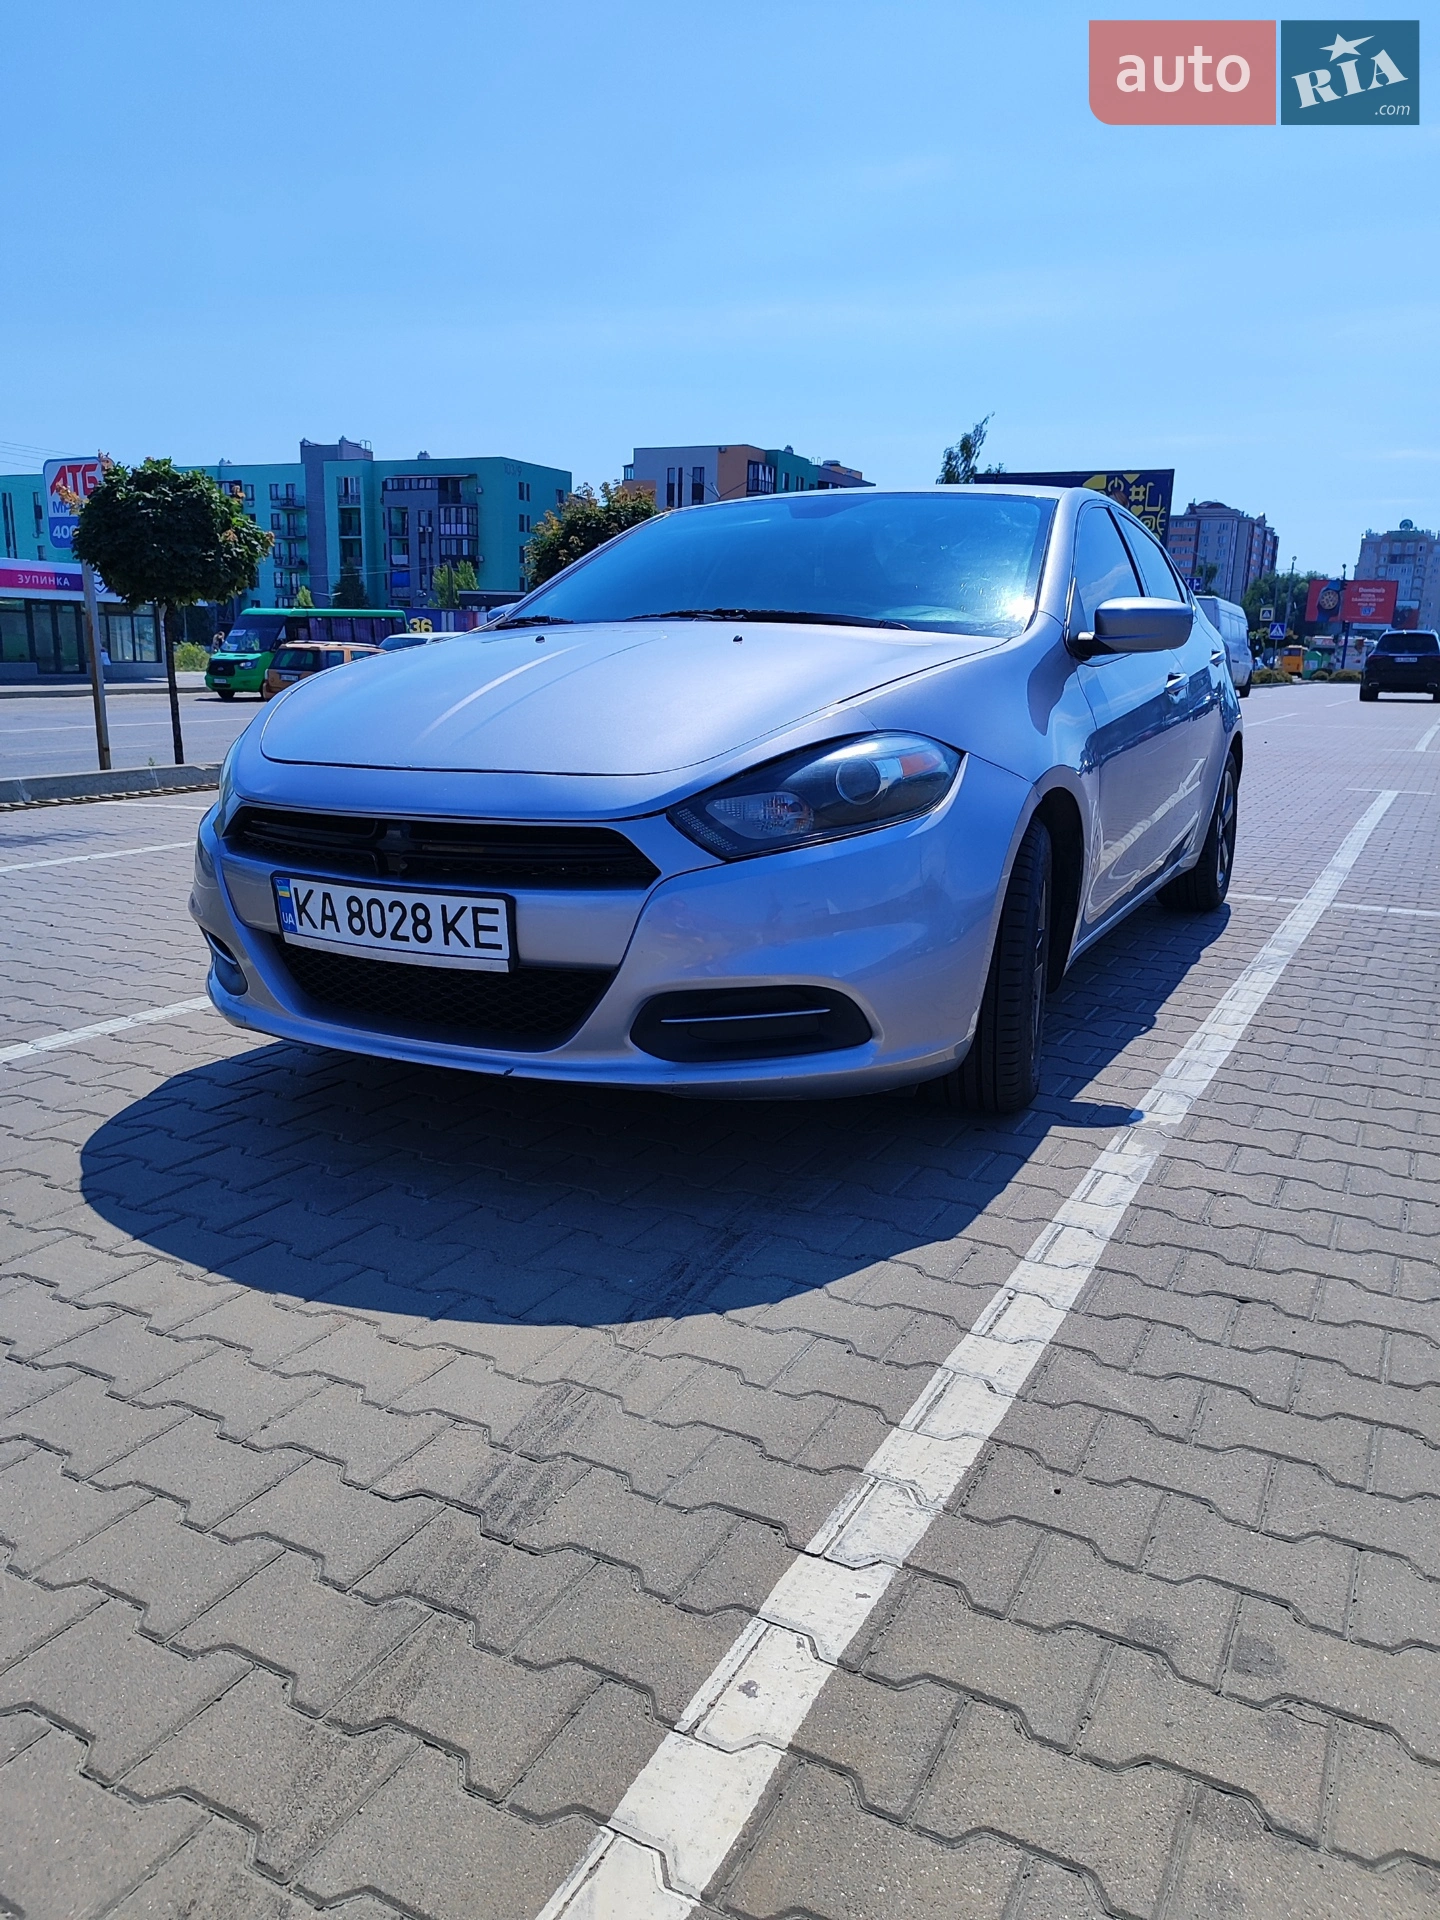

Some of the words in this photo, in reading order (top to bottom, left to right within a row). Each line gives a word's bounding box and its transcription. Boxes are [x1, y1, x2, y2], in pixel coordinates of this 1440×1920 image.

[50, 464, 98, 497] АТБ
[17, 573, 71, 587] ЗУПИНКА
[281, 911, 296, 926] UA
[346, 895, 433, 944] 8028
